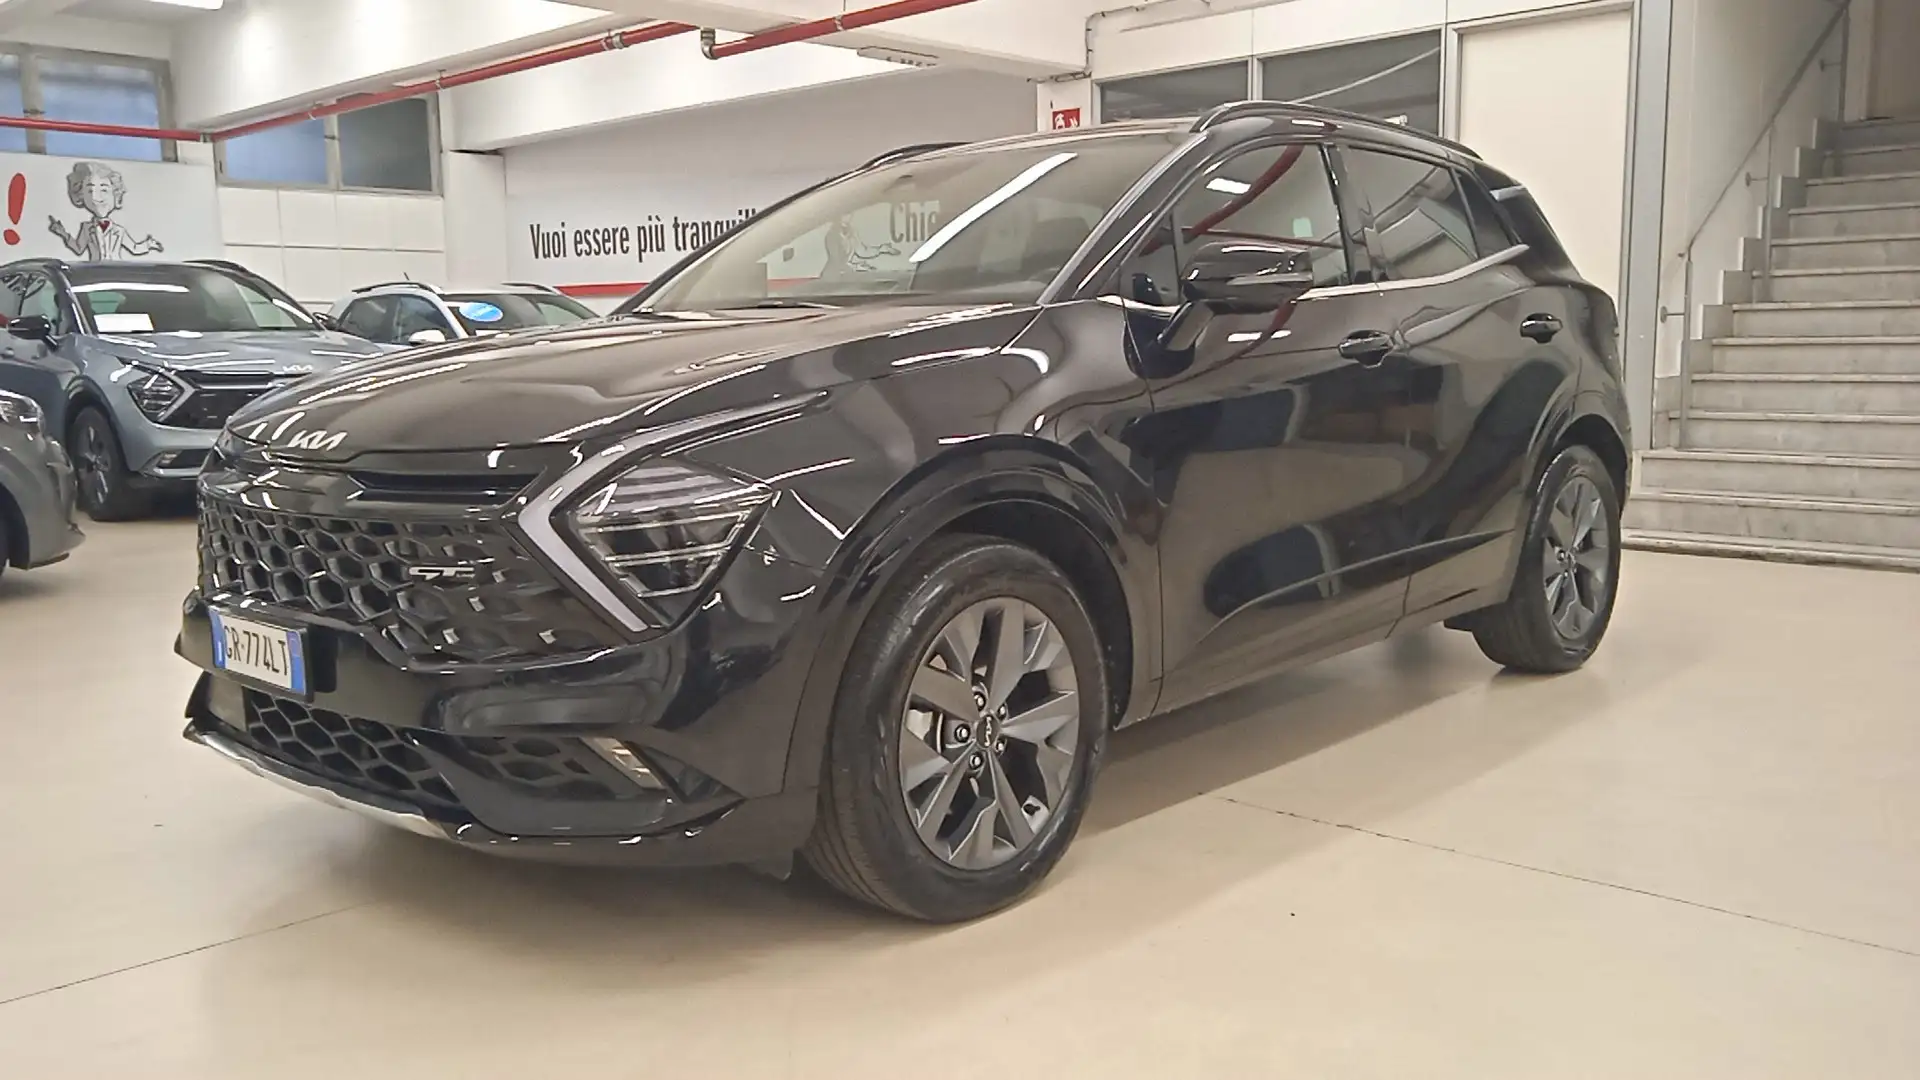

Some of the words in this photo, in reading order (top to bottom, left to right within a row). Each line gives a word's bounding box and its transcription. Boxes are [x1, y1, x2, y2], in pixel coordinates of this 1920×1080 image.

[530, 222, 567, 259] Vuoi
[573, 224, 630, 256] essere
[637, 215, 665, 263] più
[672, 208, 757, 251] tranq
